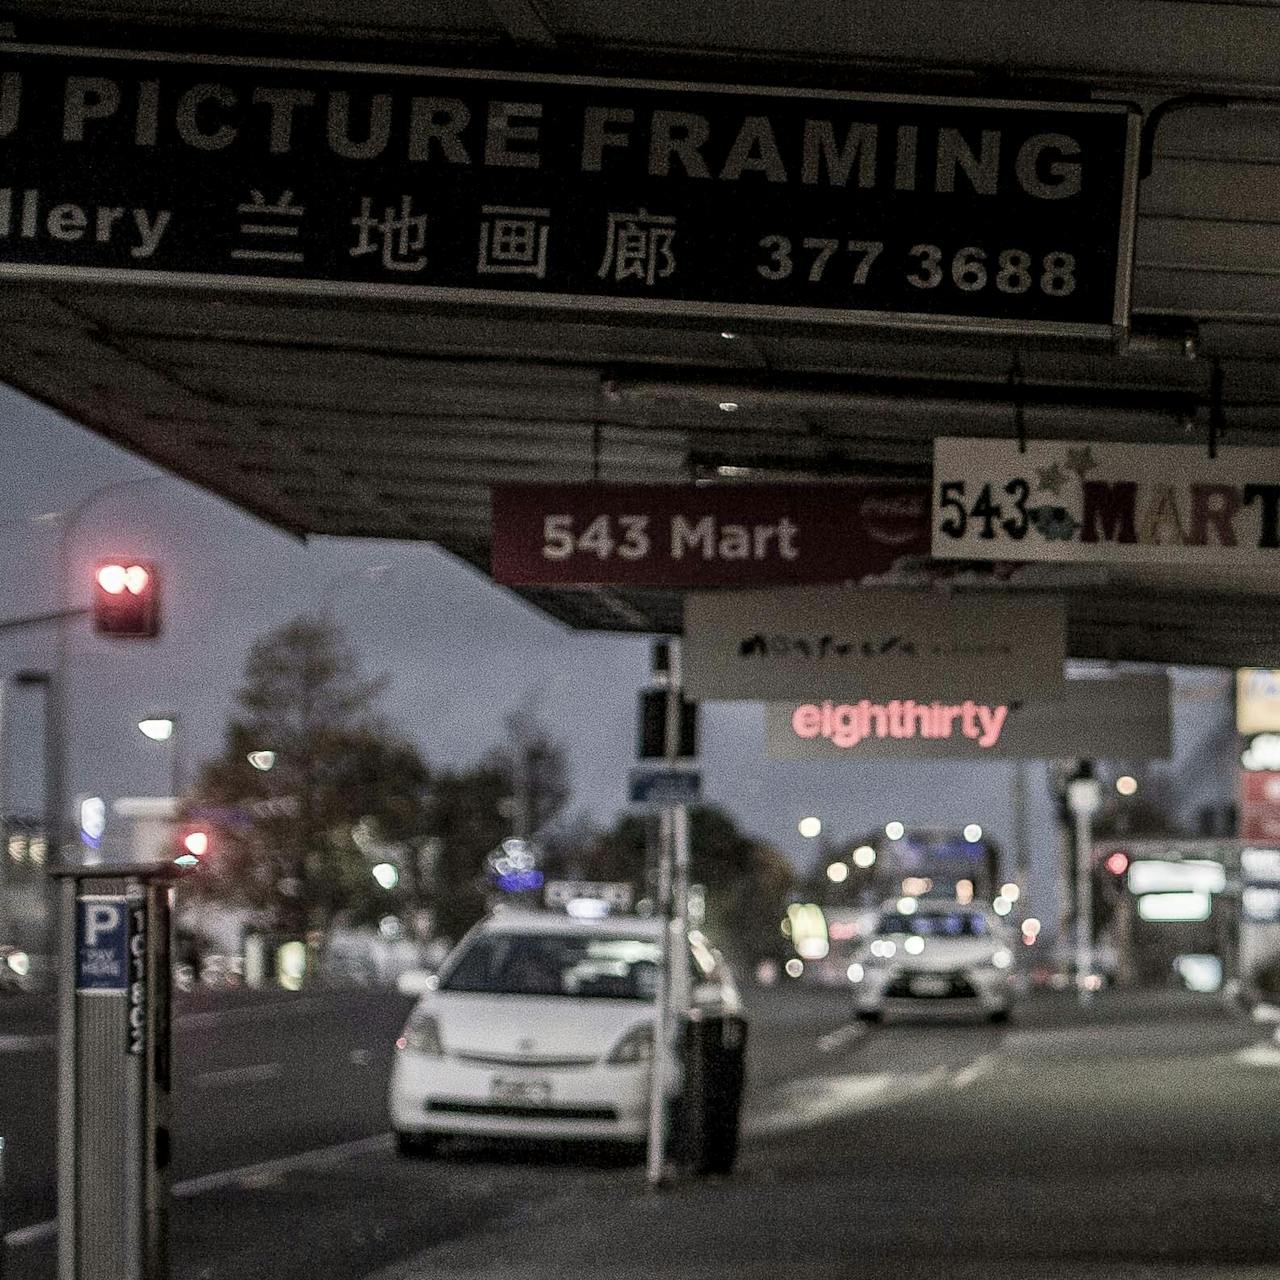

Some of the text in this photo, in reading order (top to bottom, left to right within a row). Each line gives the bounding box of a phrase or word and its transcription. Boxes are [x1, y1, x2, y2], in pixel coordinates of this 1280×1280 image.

[62, 77, 544, 168] PICTURE
[580, 106, 1084, 200] FRAMING
[230, 190, 677, 286] 兰地画廊
[756, 234, 884, 285] 377
[905, 243, 1077, 297] 3688
[940, 478, 1030, 540] 543
[542, 514, 798, 561] 543 Mart
[791, 700, 1010, 748] eighthirty
[84, 903, 120, 947] P
